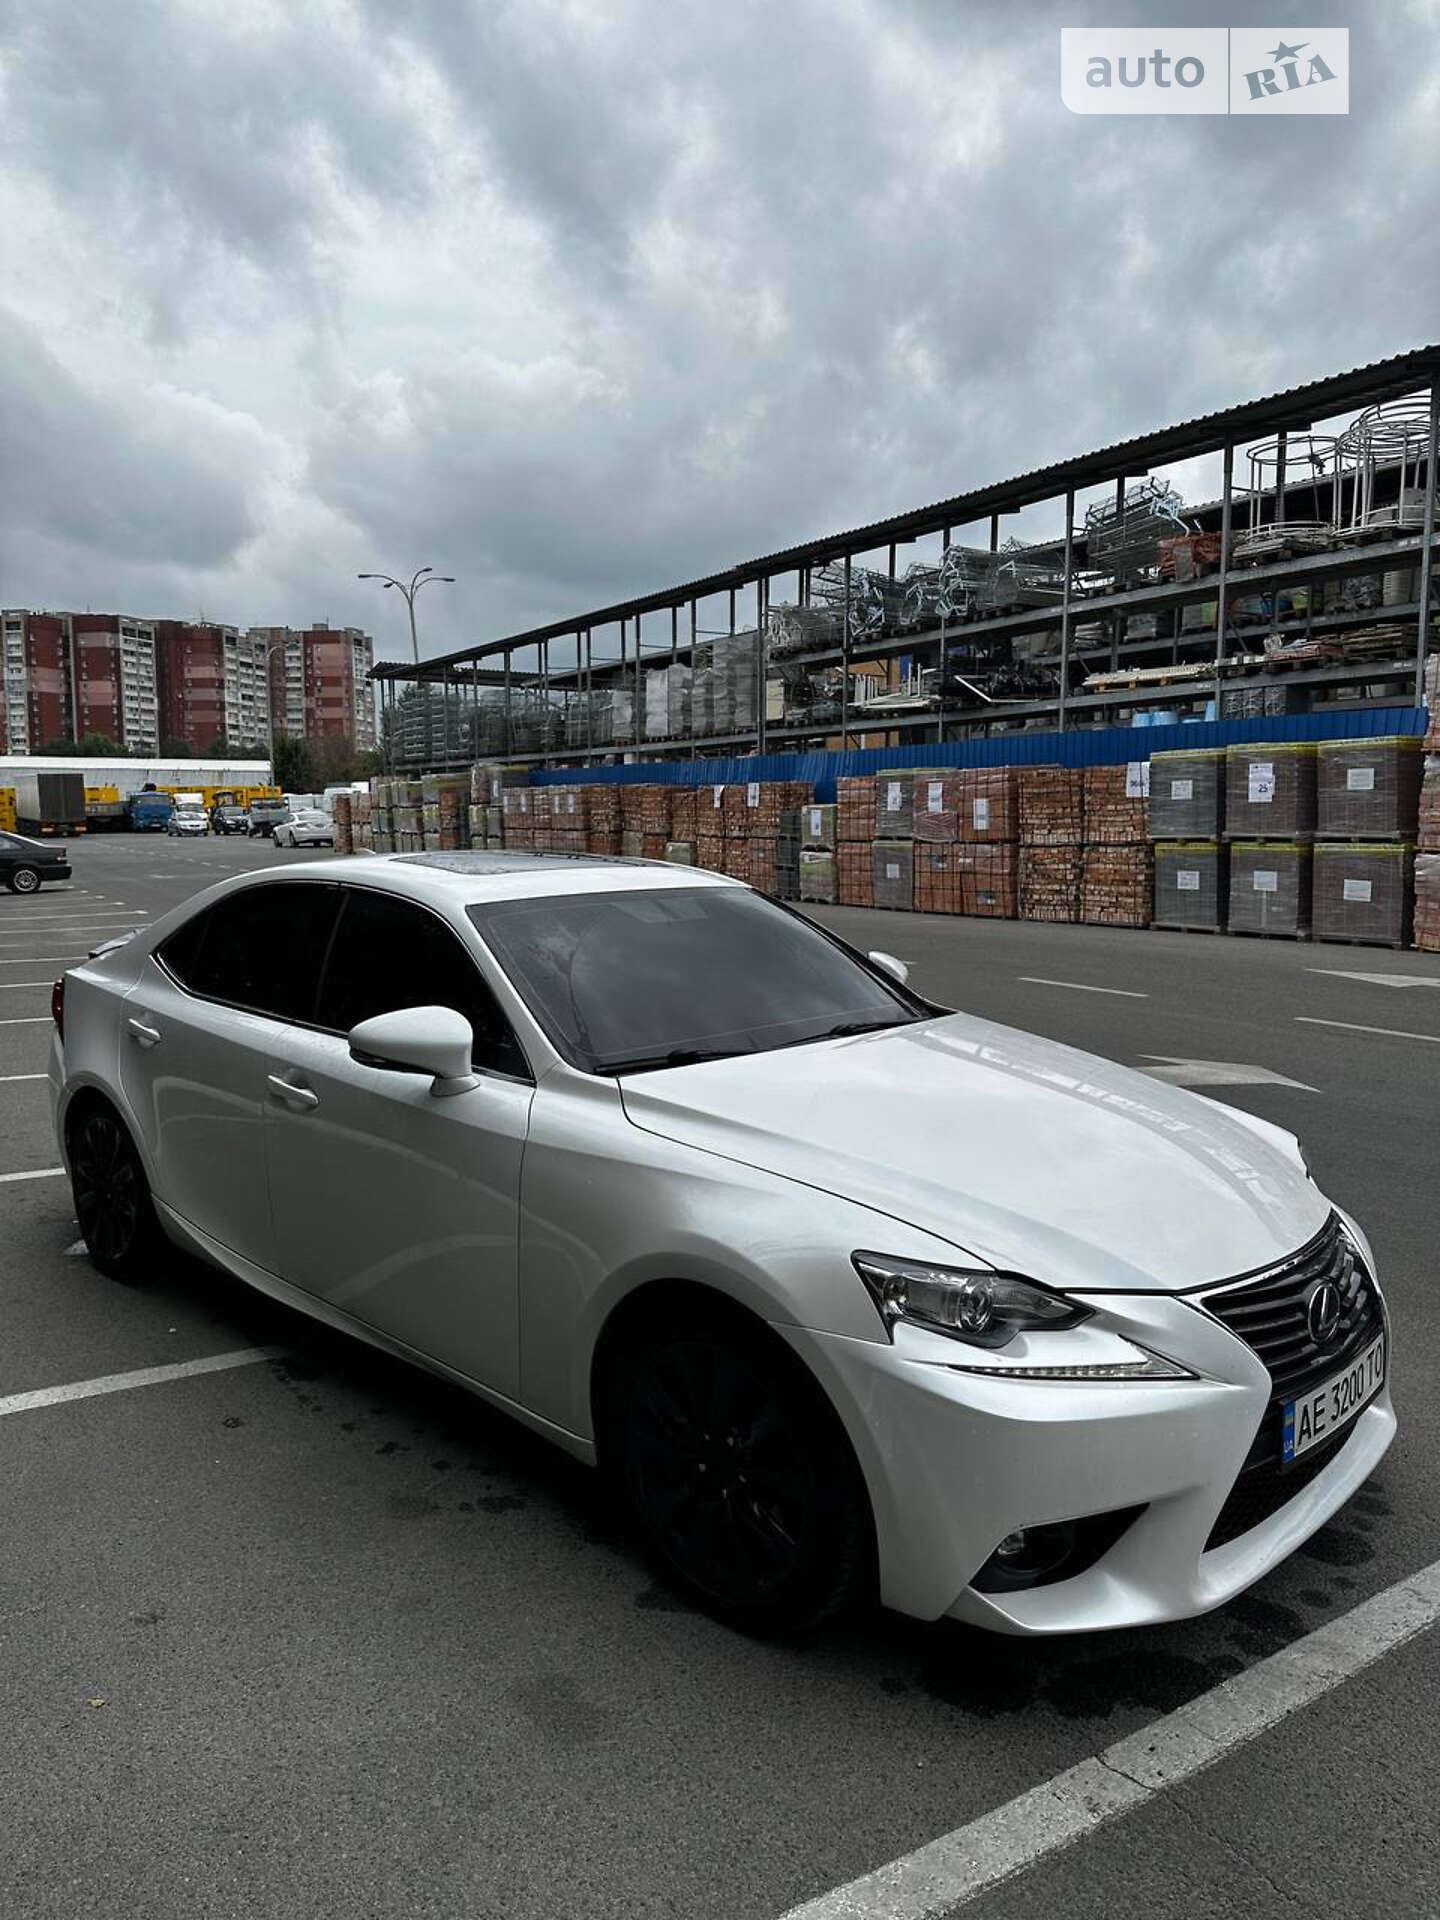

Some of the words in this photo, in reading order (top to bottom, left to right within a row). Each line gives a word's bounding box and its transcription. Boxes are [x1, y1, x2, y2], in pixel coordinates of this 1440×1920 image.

[1298, 1393, 1326, 1446] AE
[1331, 1363, 1365, 1421] 3200
[1367, 1343, 1383, 1387] TO
